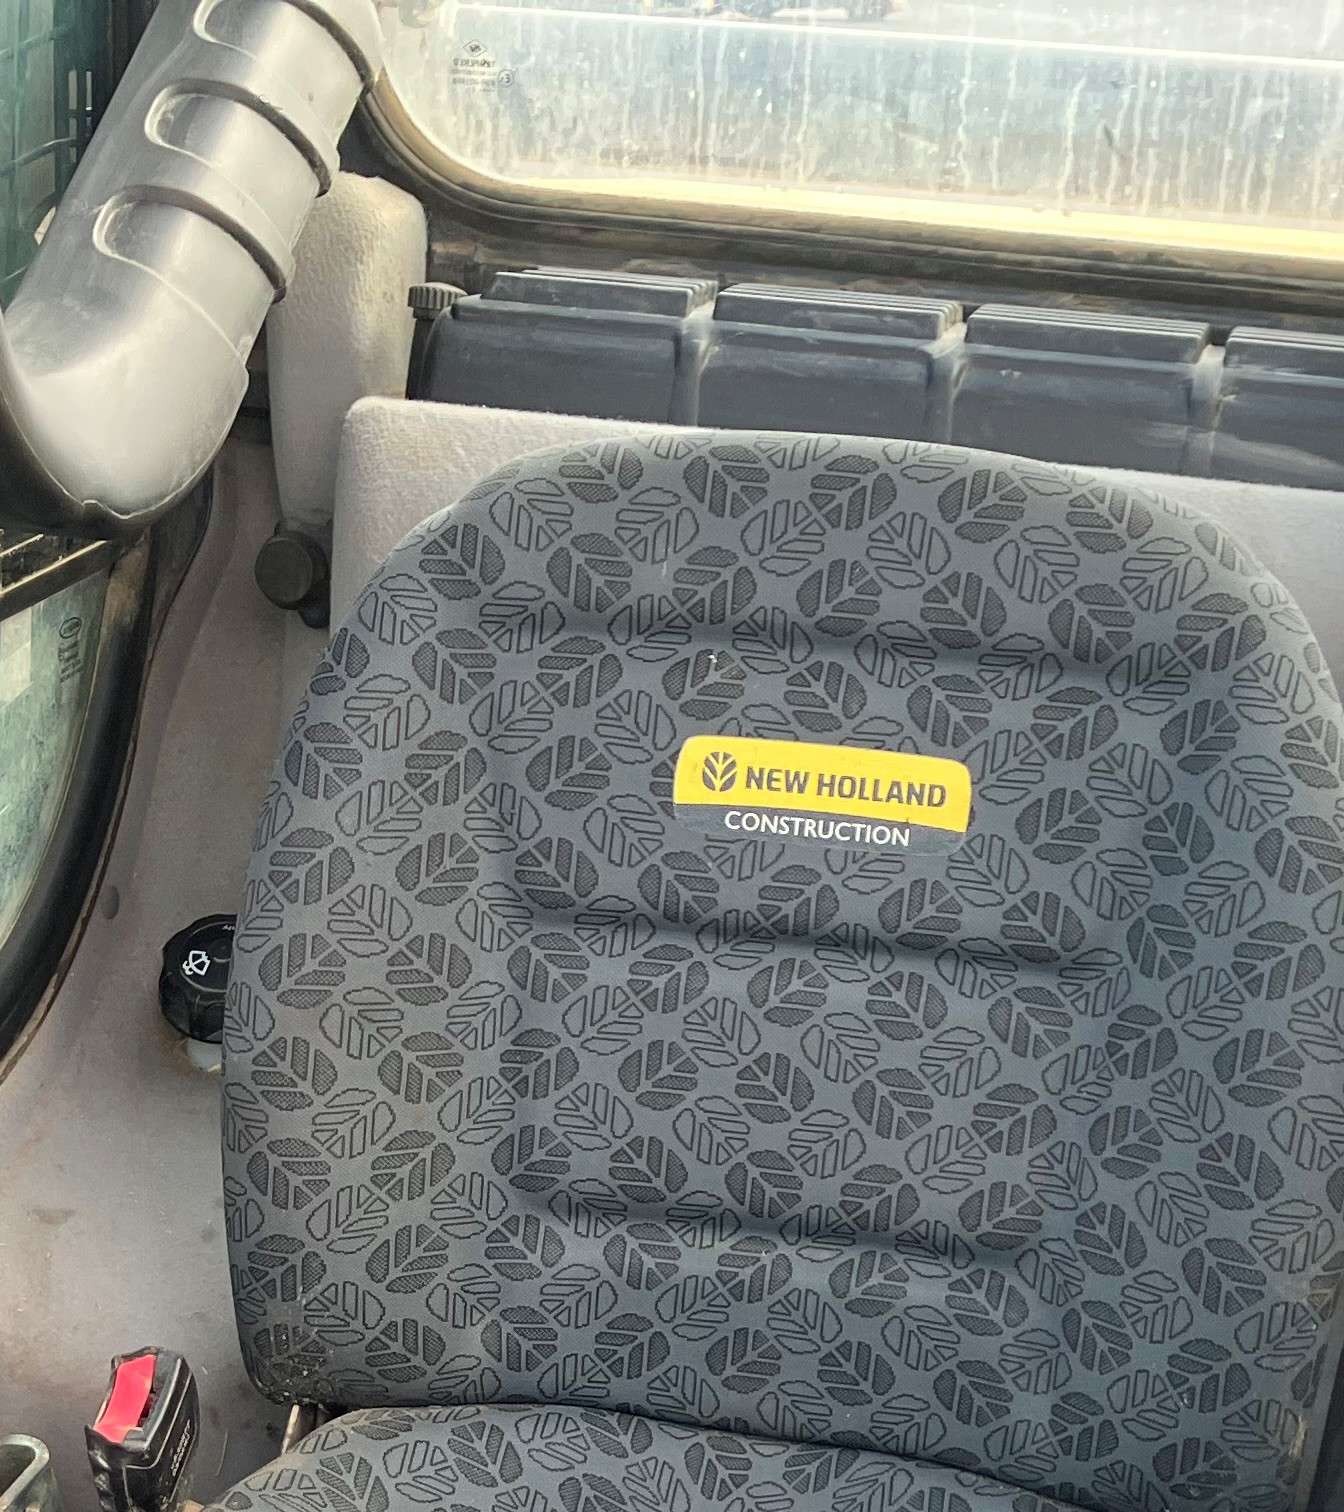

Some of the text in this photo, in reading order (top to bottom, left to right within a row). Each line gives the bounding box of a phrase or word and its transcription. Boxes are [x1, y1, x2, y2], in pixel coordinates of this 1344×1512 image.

[746, 765, 947, 808] NEW HOLLAND
[724, 811, 910, 846] CONSTRUCTION
